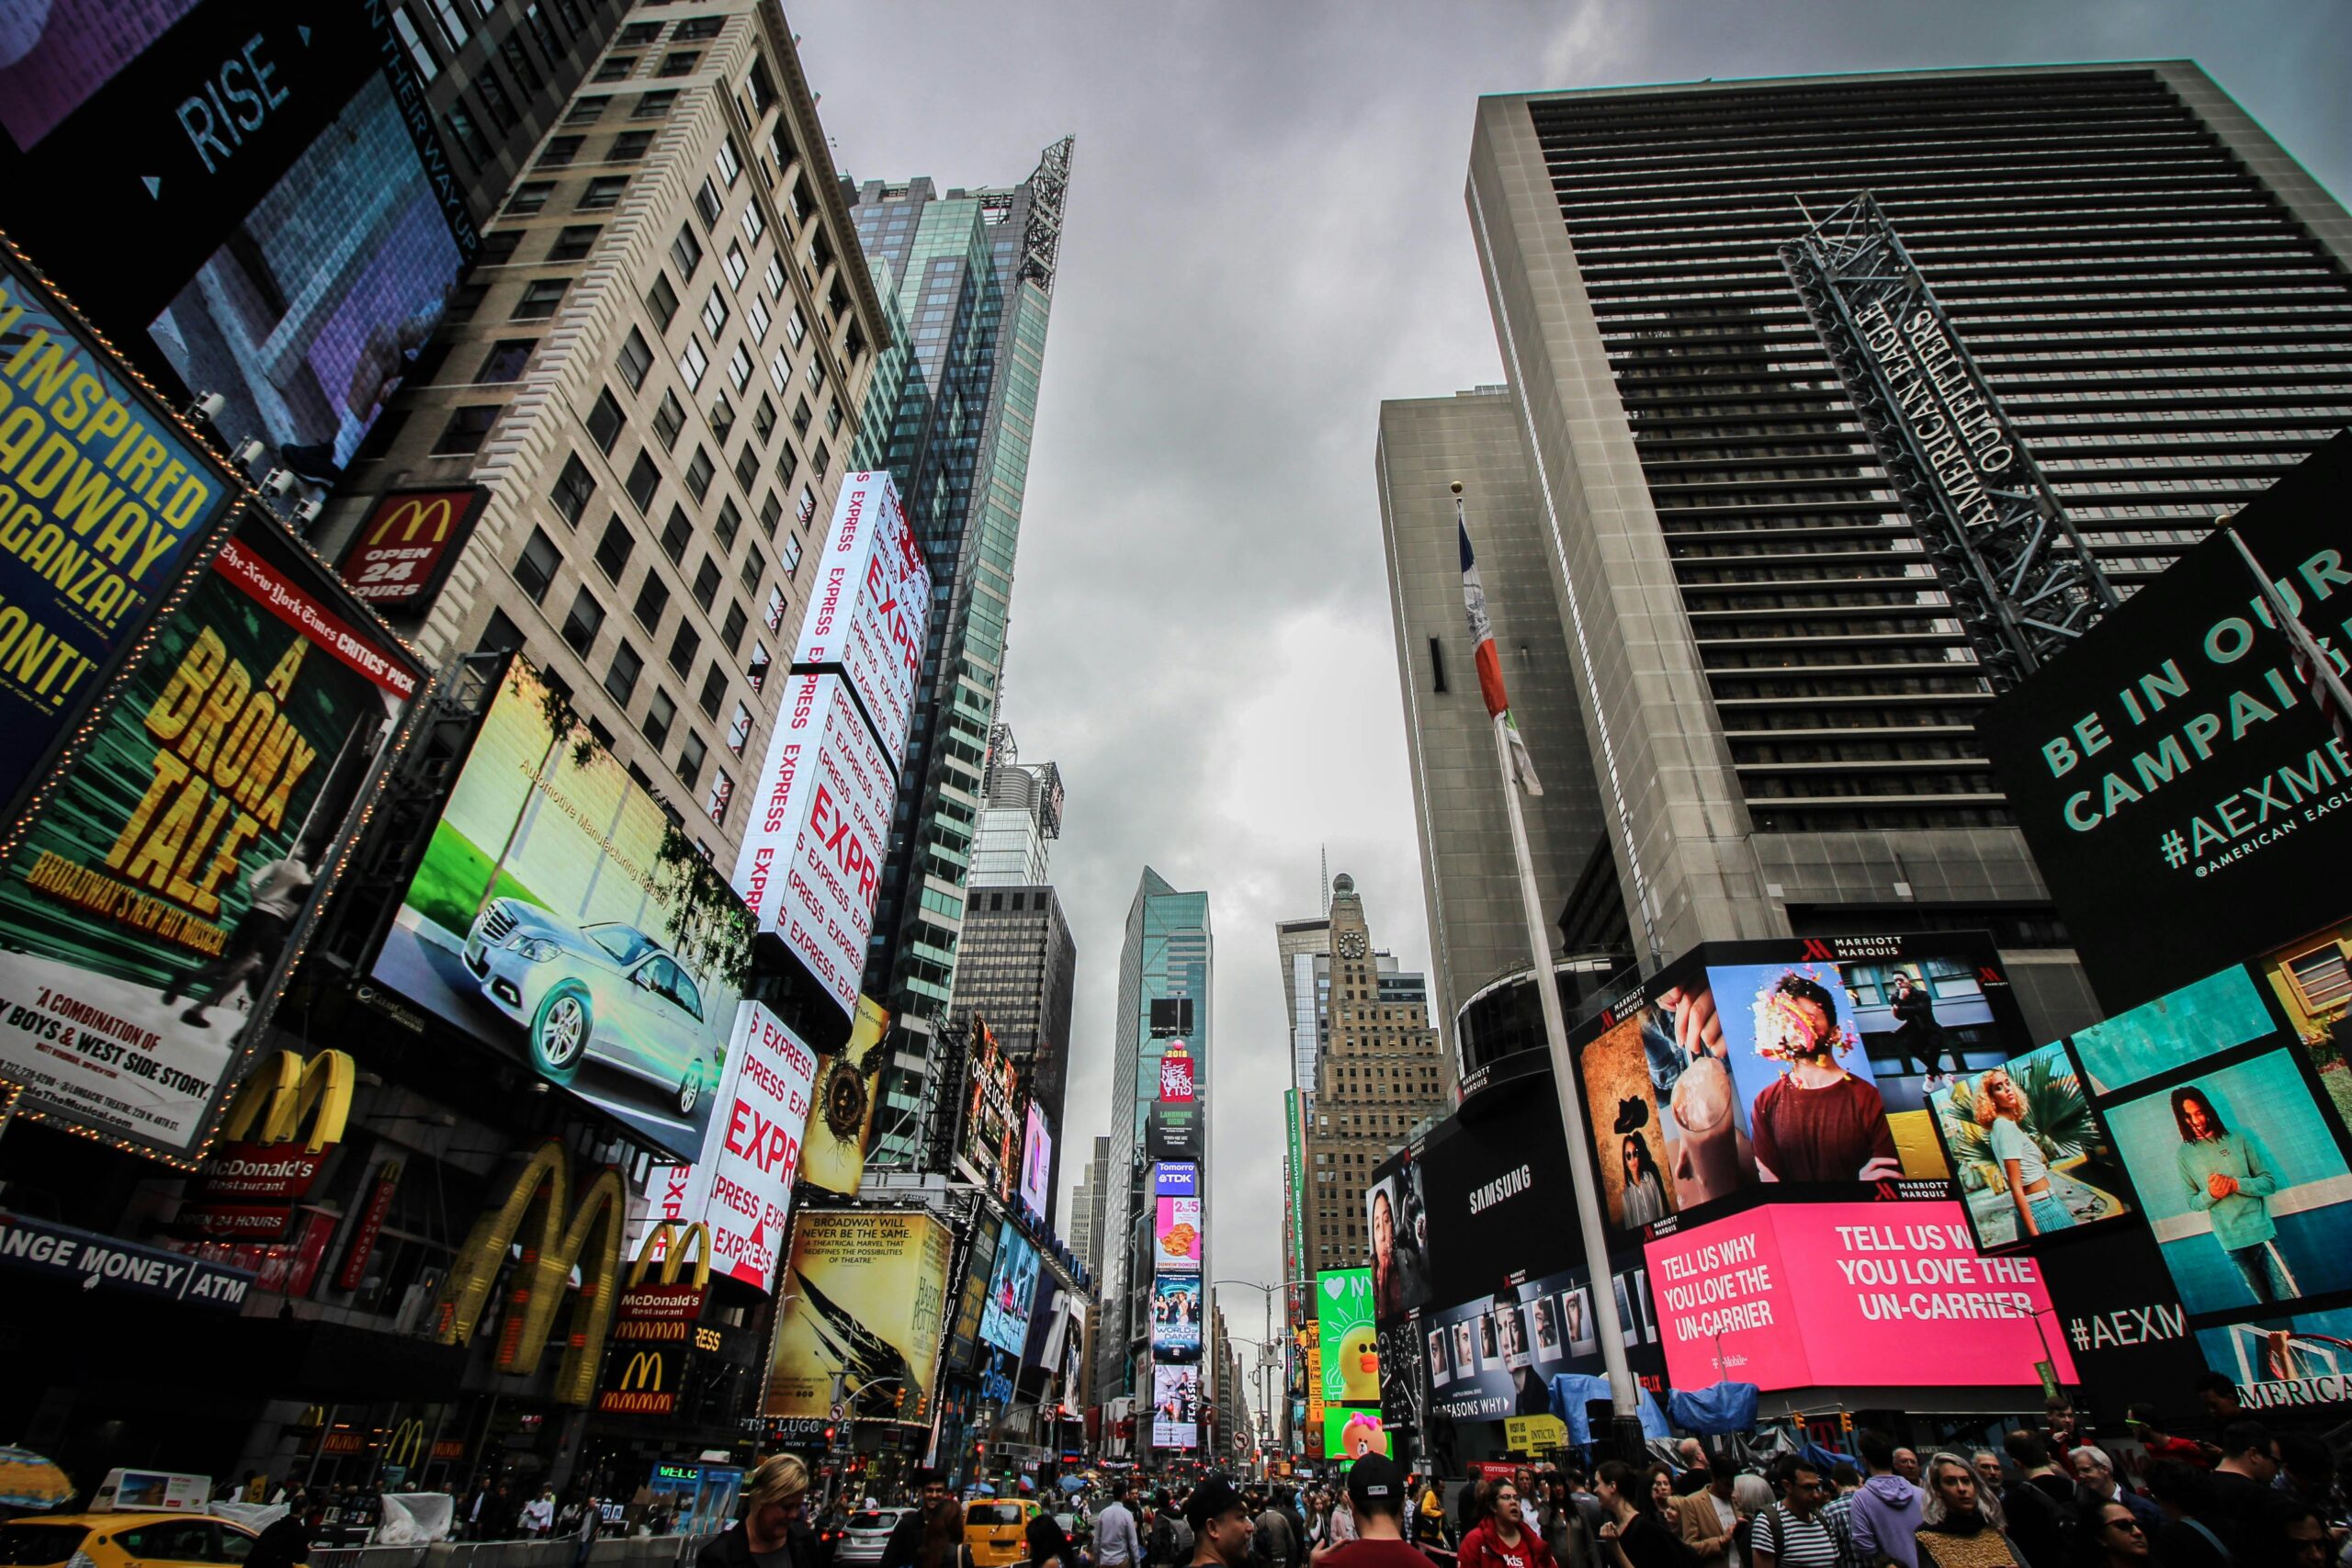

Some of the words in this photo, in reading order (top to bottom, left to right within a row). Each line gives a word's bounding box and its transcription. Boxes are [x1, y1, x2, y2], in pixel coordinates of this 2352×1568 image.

[175, 32, 289, 174] RISE
[381, 28, 429, 135] THEIR
[424, 137, 459, 208] WAY
[1853, 299, 1916, 384] EAGLE
[1904, 309, 2014, 473] OUTFITTERS
[2, 327, 209, 531] INSPIRED
[1898, 378, 1999, 529] AMERICAN
[837, 491, 866, 553] EXPRESS
[359, 562, 416, 582] 24
[366, 548, 432, 561] OPEN
[888, 521, 916, 593] EXPRESS
[354, 584, 420, 596] OURS
[815, 568, 845, 637] EXPRESS
[220, 544, 244, 570] The
[243, 562, 272, 592] New
[270, 581, 303, 617] York
[301, 606, 337, 641] Times
[386, 667, 415, 694] PICK
[866, 608, 899, 679] EXPRESS
[265, 635, 311, 702] A
[2041, 711, 2112, 779] BE
[2119, 659, 2190, 725] IN
[2204, 548, 2352, 664] OUR
[854, 661, 887, 732] EXPRESS
[143, 625, 317, 831] BRONX
[2064, 617, 2352, 831] CAMPAI
[763, 744, 801, 833] EXPRESS
[835, 730, 873, 800] EXPRESS
[104, 749, 260, 915] TALE
[519, 759, 577, 819] Automotive
[578, 813, 639, 882] Manufacturing
[2195, 819, 2297, 878] @AMERICAN
[808, 846, 850, 913] EXPRESS
[129, 892, 164, 927] NEW
[156, 902, 186, 934] HIT
[180, 913, 229, 953] MUSICAL
[827, 918, 865, 976] EXPRESS
[1835, 935, 1903, 948] MARRIOTT
[790, 919, 835, 983] EXPRESS
[1838, 945, 1899, 958] MARQUIS
[1613, 986, 1645, 1012] MARRIOTT
[1615, 998, 1645, 1021] MARQUIS
[6, 1006, 62, 1040] BOYS
[58, 1027, 75, 1046] &
[75, 1032, 126, 1065] WEST
[122, 1053, 162, 1081] SIDE
[50, 996, 144, 1046] COMBINATION
[141, 1032, 162, 1053] OF
[763, 1021, 812, 1082] EXPRESS
[1167, 1050, 1188, 1058] 2018
[972, 1057, 993, 1099] OFFICE
[991, 1085, 1021, 1136] LOCATIONS
[207, 1179, 286, 1191] Restaurant
[1168, 1175, 1192, 1183] TDK
[1469, 1164, 1532, 1215] SAMSUNG
[1898, 1181, 1950, 1191] MARRIOTT
[1900, 1189, 1947, 1199] MARQUIS
[178, 1214, 213, 1227] OPEN
[215, 1215, 232, 1226] 24
[235, 1216, 283, 1228] HOURS
[879, 1218, 905, 1228] WILL
[1175, 1201, 1182, 1213] 2
[1654, 1215, 1678, 1229] MARRIOTT
[1656, 1224, 1678, 1236] MARQUIS
[713, 1225, 772, 1275] EXPRESS
[801, 1229, 836, 1238] NEVER
[840, 1229, 854, 1238] BE
[857, 1229, 877, 1238] THE
[880, 1229, 912, 1239] SAME.
[1662, 1255, 1698, 1282] TELL
[1698, 1246, 1720, 1272] US
[1719, 1234, 1756, 1267] WHY
[1836, 1226, 1899, 1251] TELL
[1905, 1225, 1946, 1250] US
[78, 1247, 184, 1289] MONEY
[191, 1273, 248, 1303] ATM
[918, 1276, 942, 1310] HARRY
[1664, 1283, 1695, 1313] YOU
[1694, 1272, 1736, 1307] LOVE
[1736, 1265, 1773, 1293] THE
[1837, 1259, 1899, 1285] YOU
[1905, 1259, 1976, 1285] LOVE
[1974, 1258, 2037, 1284] THE
[631, 1308, 684, 1316] Restaurant
[1675, 1300, 1774, 1342] UN-CARRIER
[1858, 1293, 2036, 1321] UN-CARRIER
[2071, 1303, 2186, 1351] #AEXM
[1480, 1396, 1501, 1414] WHY
[1510, 1423, 1520, 1433] VISIT
[1520, 1422, 1526, 1432] US
[1531, 1428, 1555, 1440] INVICTA
